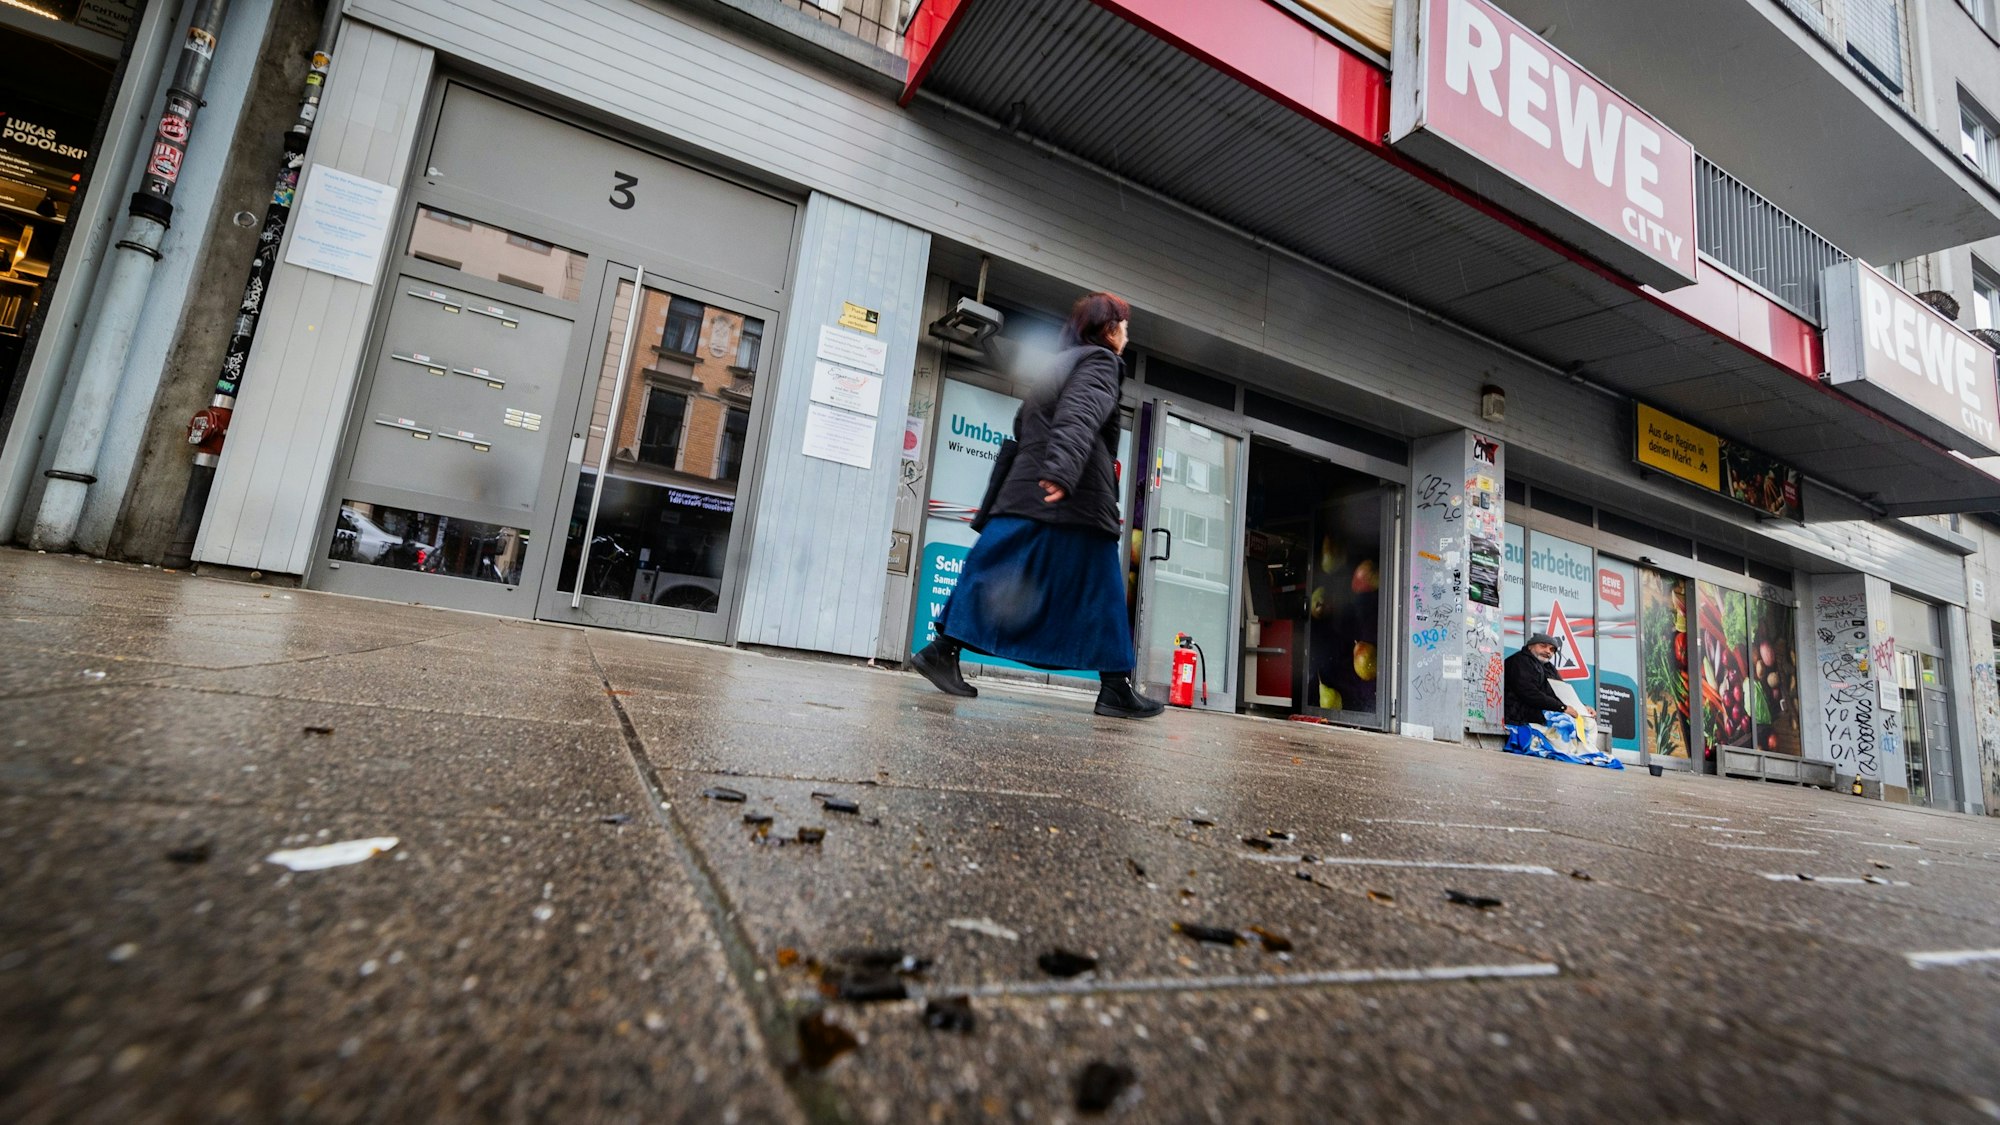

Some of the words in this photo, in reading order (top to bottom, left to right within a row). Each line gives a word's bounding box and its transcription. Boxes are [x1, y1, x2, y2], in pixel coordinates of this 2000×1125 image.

[1445, 0, 1664, 219] REWE
[6, 117, 56, 140] LUKAS
[609, 170, 638, 210] 3
[1622, 207, 1682, 261] CITY
[1866, 277, 1981, 411] REWE
[1961, 407, 1993, 441] CITY
[949, 440, 963, 453] Wir
[1648, 423, 1661, 439] Aus
[1663, 428, 1674, 443] der
[1675, 434, 1697, 453] Region
[1698, 443, 1704, 456] in
[1648, 439, 1671, 458] deinen
[935, 555, 966, 574] Schl
[932, 586, 951, 596] nach
[1531, 581, 1557, 594] unseren
[1559, 585, 1579, 600] Markt!
[1602, 576, 1621, 589] REWE
